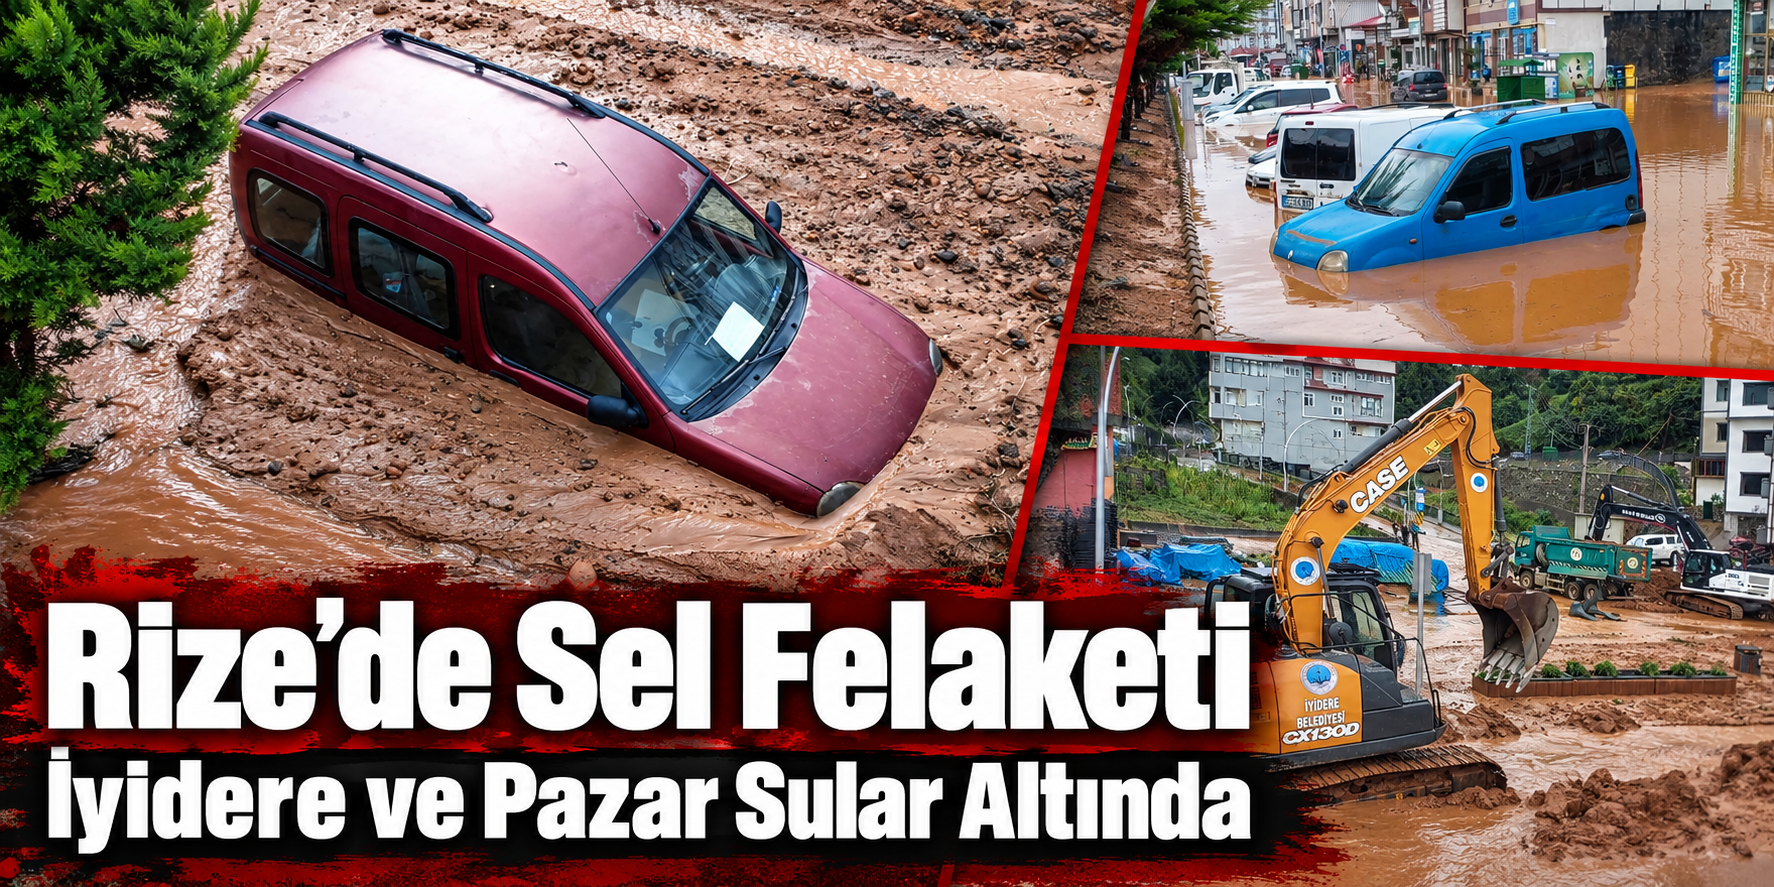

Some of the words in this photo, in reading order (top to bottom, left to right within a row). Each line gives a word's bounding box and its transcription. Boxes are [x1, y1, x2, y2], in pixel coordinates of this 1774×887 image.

[1350, 455, 1409, 513] CASE
[1304, 697, 1340, 712] İYİDERE
[1296, 710, 1346, 729] BELEDİYESİ
[1282, 722, 1361, 745] CX130D
